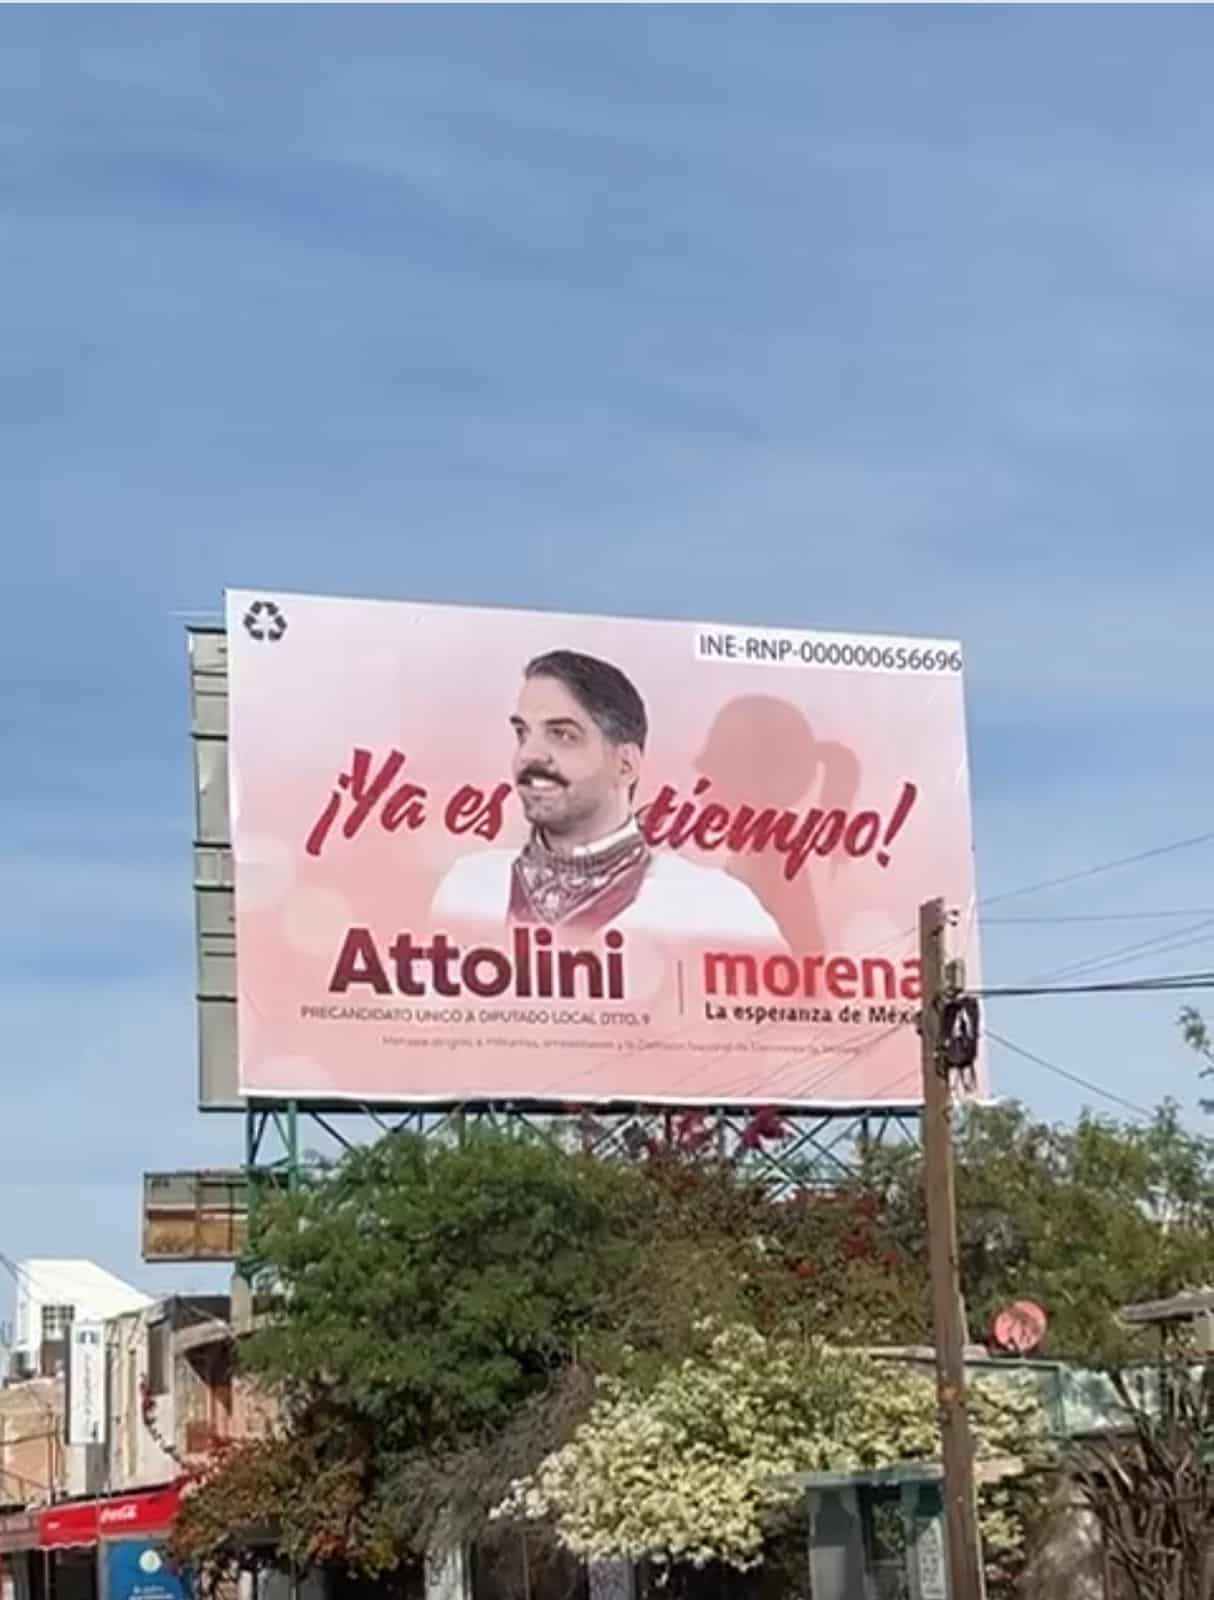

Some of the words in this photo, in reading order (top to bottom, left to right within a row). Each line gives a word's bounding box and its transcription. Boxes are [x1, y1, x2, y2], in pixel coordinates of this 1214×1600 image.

[699, 634, 962, 671] INE-RNP-000000656696
[305, 748, 427, 856] ¡Ya
[445, 782, 512, 841] es
[635, 778, 917, 880] tiempo!
[328, 927, 624, 999] Attolini
[704, 952, 922, 999] morena
[300, 1005, 413, 1023] PRECANDIDATO
[464, 1008, 477, 1024] A
[479, 1008, 550, 1025] DIPUTADO
[552, 1010, 597, 1025] LOCAL
[705, 1002, 727, 1020] La
[733, 1004, 833, 1024] esperanza
[838, 1005, 861, 1023] de
